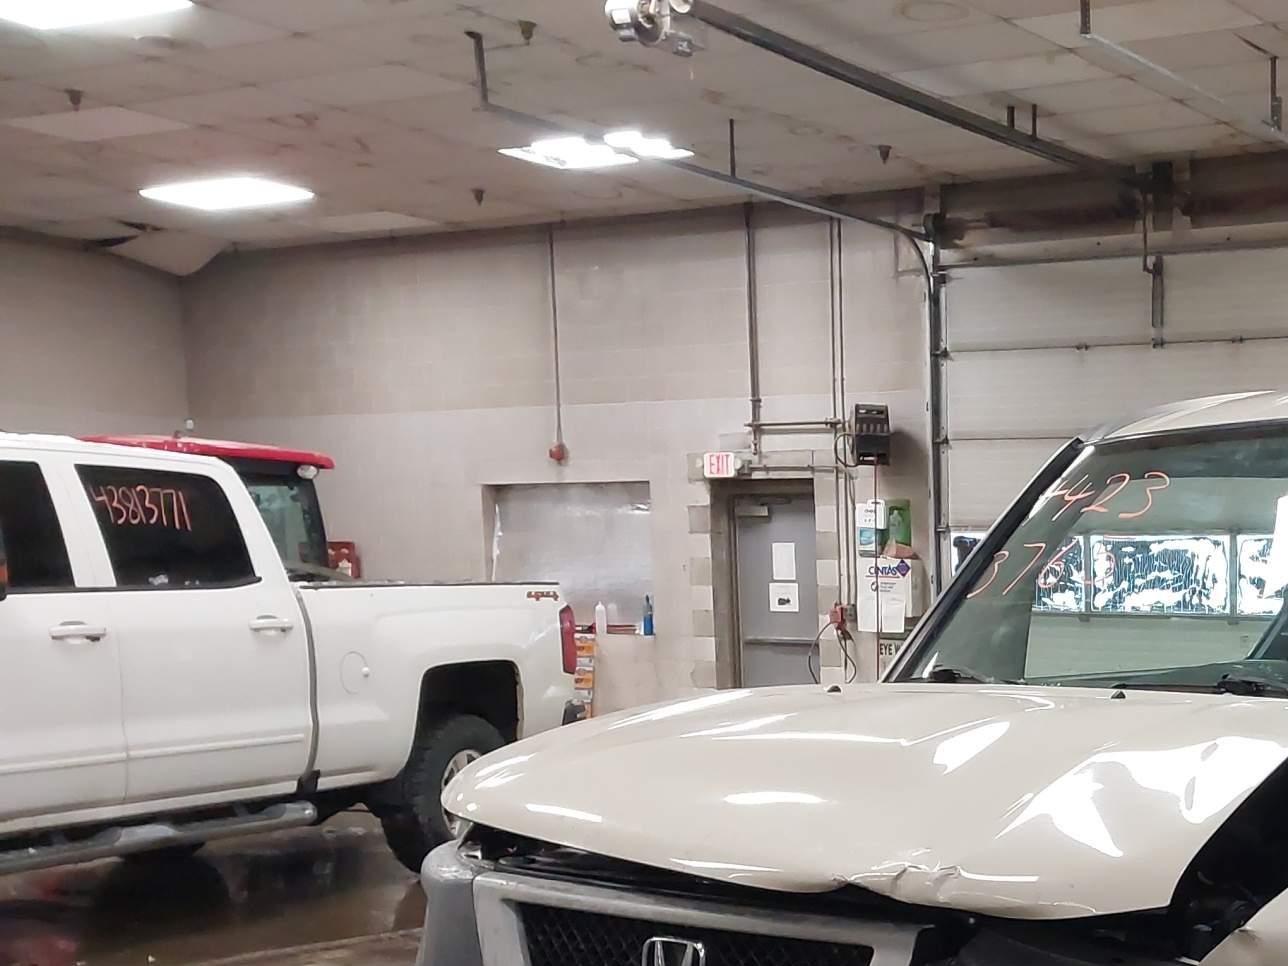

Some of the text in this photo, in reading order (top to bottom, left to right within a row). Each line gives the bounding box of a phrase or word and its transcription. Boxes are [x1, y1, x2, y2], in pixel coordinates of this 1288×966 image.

[709, 454, 731, 475] EXIT
[88, 484, 192, 532] 43813771
[868, 565, 897, 576] CNTAS
[879, 643, 893, 655] EYE
